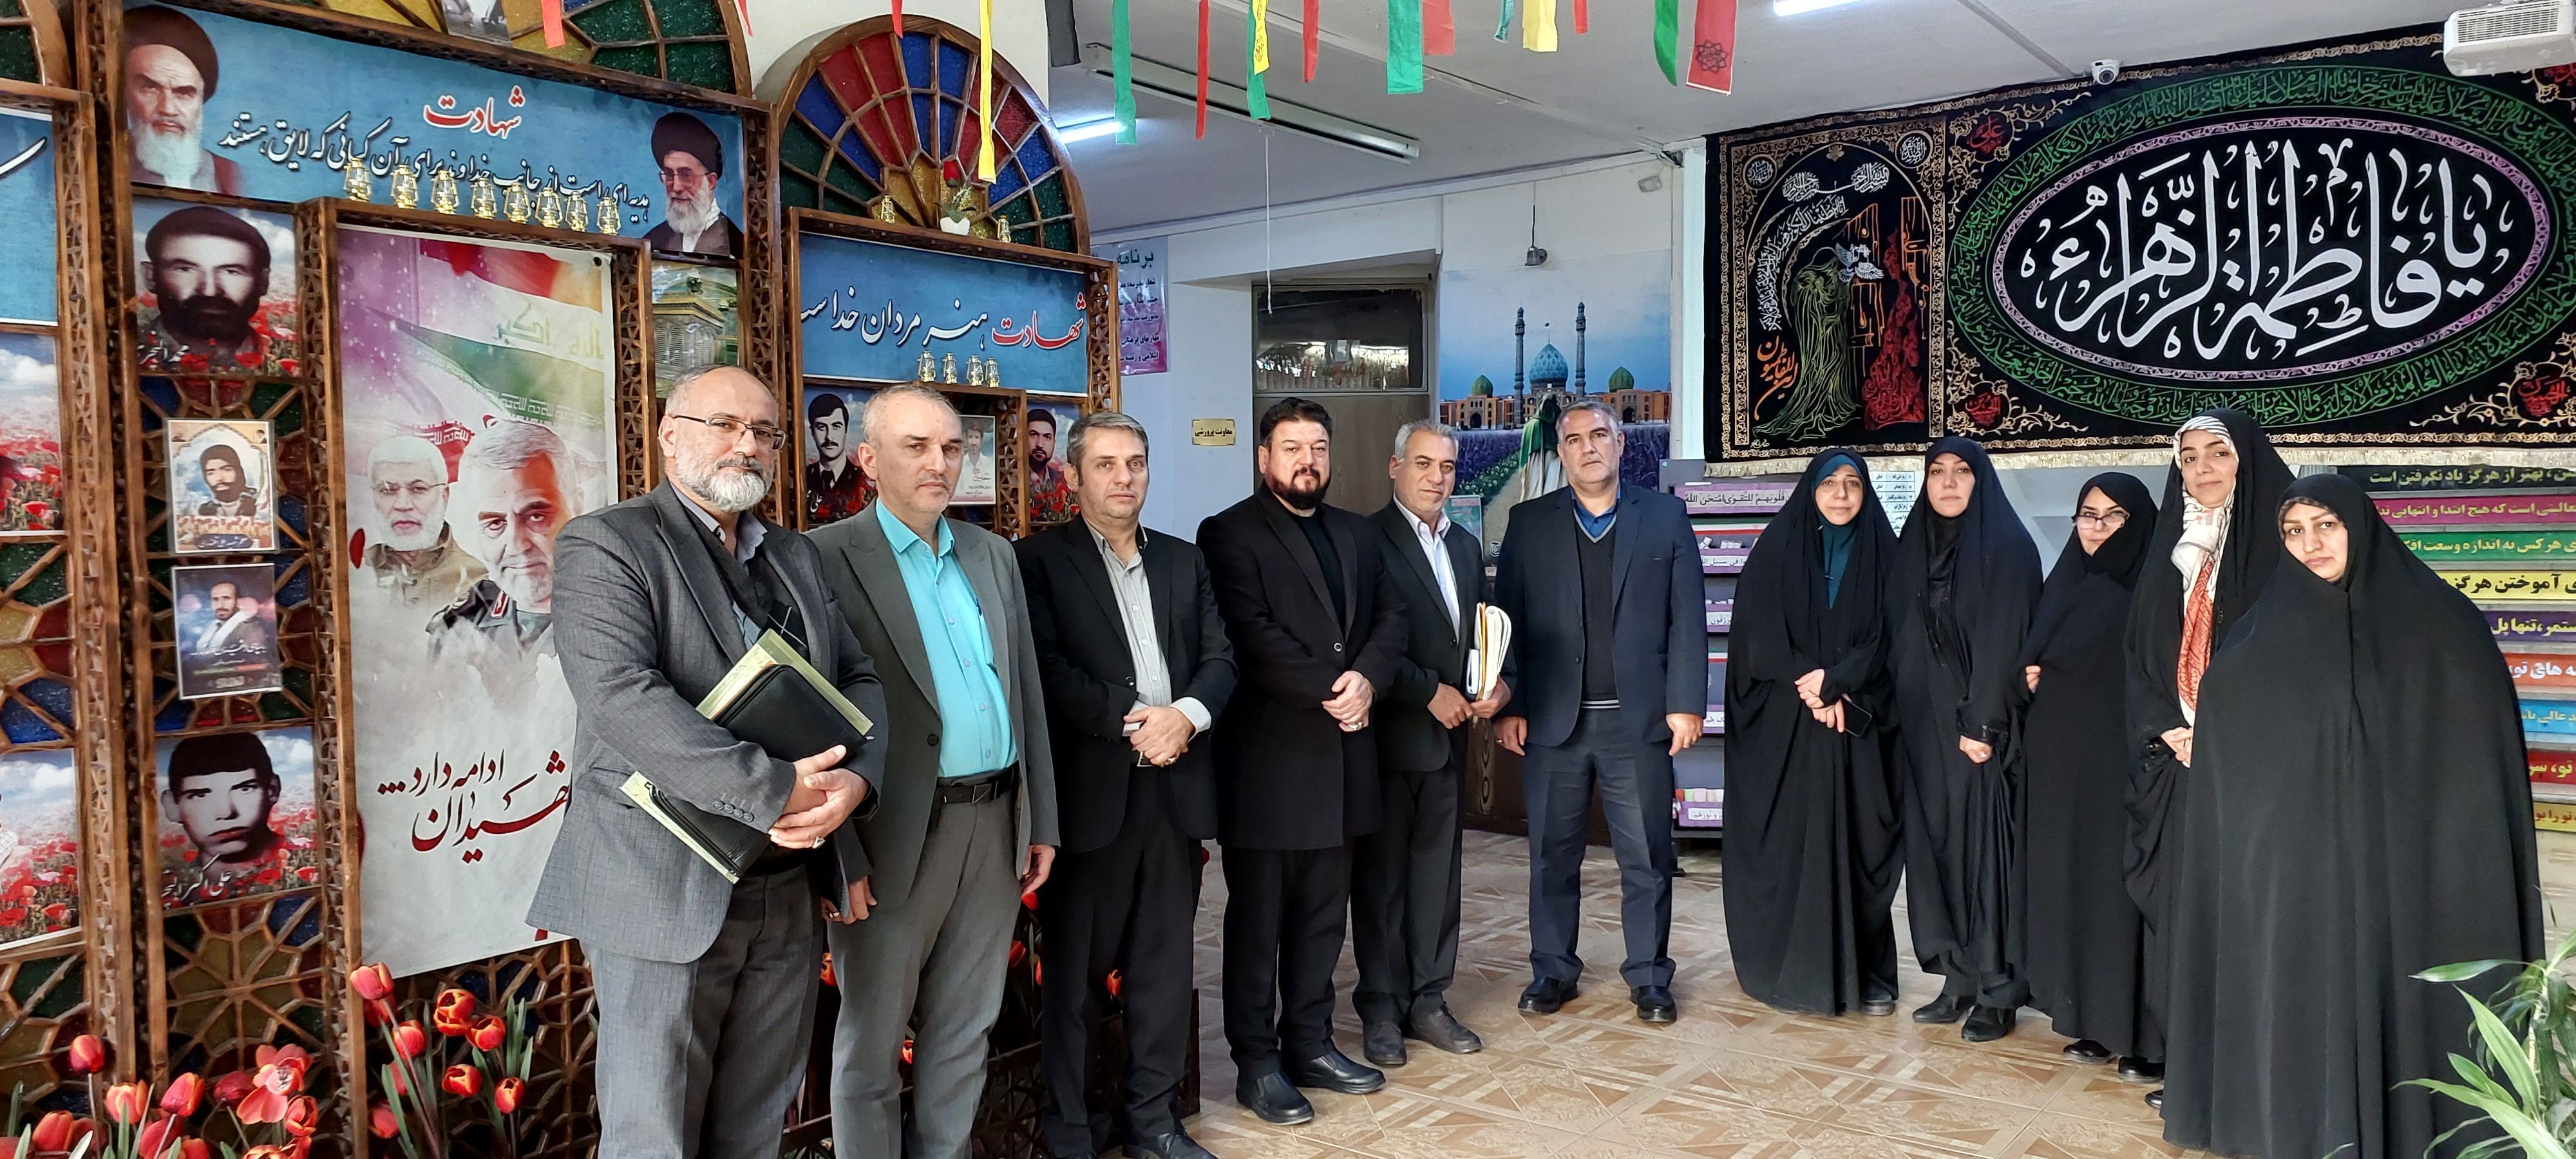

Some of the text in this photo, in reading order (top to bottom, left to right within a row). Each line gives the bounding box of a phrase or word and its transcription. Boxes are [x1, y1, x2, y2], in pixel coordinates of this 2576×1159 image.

[423, 84, 526, 139] شهادت
[260, 118, 310, 173] لایق
[327, 116, 392, 171] کسانی
[371, 137, 410, 176] آن
[414, 148, 444, 178] برای
[559, 175, 601, 195] است
[1117, 248, 1154, 269] برنامه
[801, 286, 1088, 352] شهادت هنر مردان خداس
[1195, 427, 1233, 437] معاونت پرورشی
[2369, 470, 2398, 484] است
[2399, 469, 2443, 487] نگرفتن
[2444, 471, 2463, 484] یاد
[2501, 468, 2515, 483] از
[2517, 469, 2544, 483] بهتر
[2391, 504, 2430, 519] انتهایی
[2432, 507, 2439, 517] و
[2440, 504, 2465, 516] ابتدا
[2467, 505, 2490, 518] هیچ
[2492, 504, 2507, 514] که
[2508, 503, 2535, 514] است
[2423, 542, 2460, 554] وسعت
[2462, 539, 2501, 552] اندازه
[2501, 542, 2515, 550] به
[2494, 572, 2562, 594] آموختن
[2490, 617, 2509, 636] پل
[2510, 617, 2538, 634] تنها
[2530, 661, 2562, 679] های
[450, 748, 505, 791] ادامه
